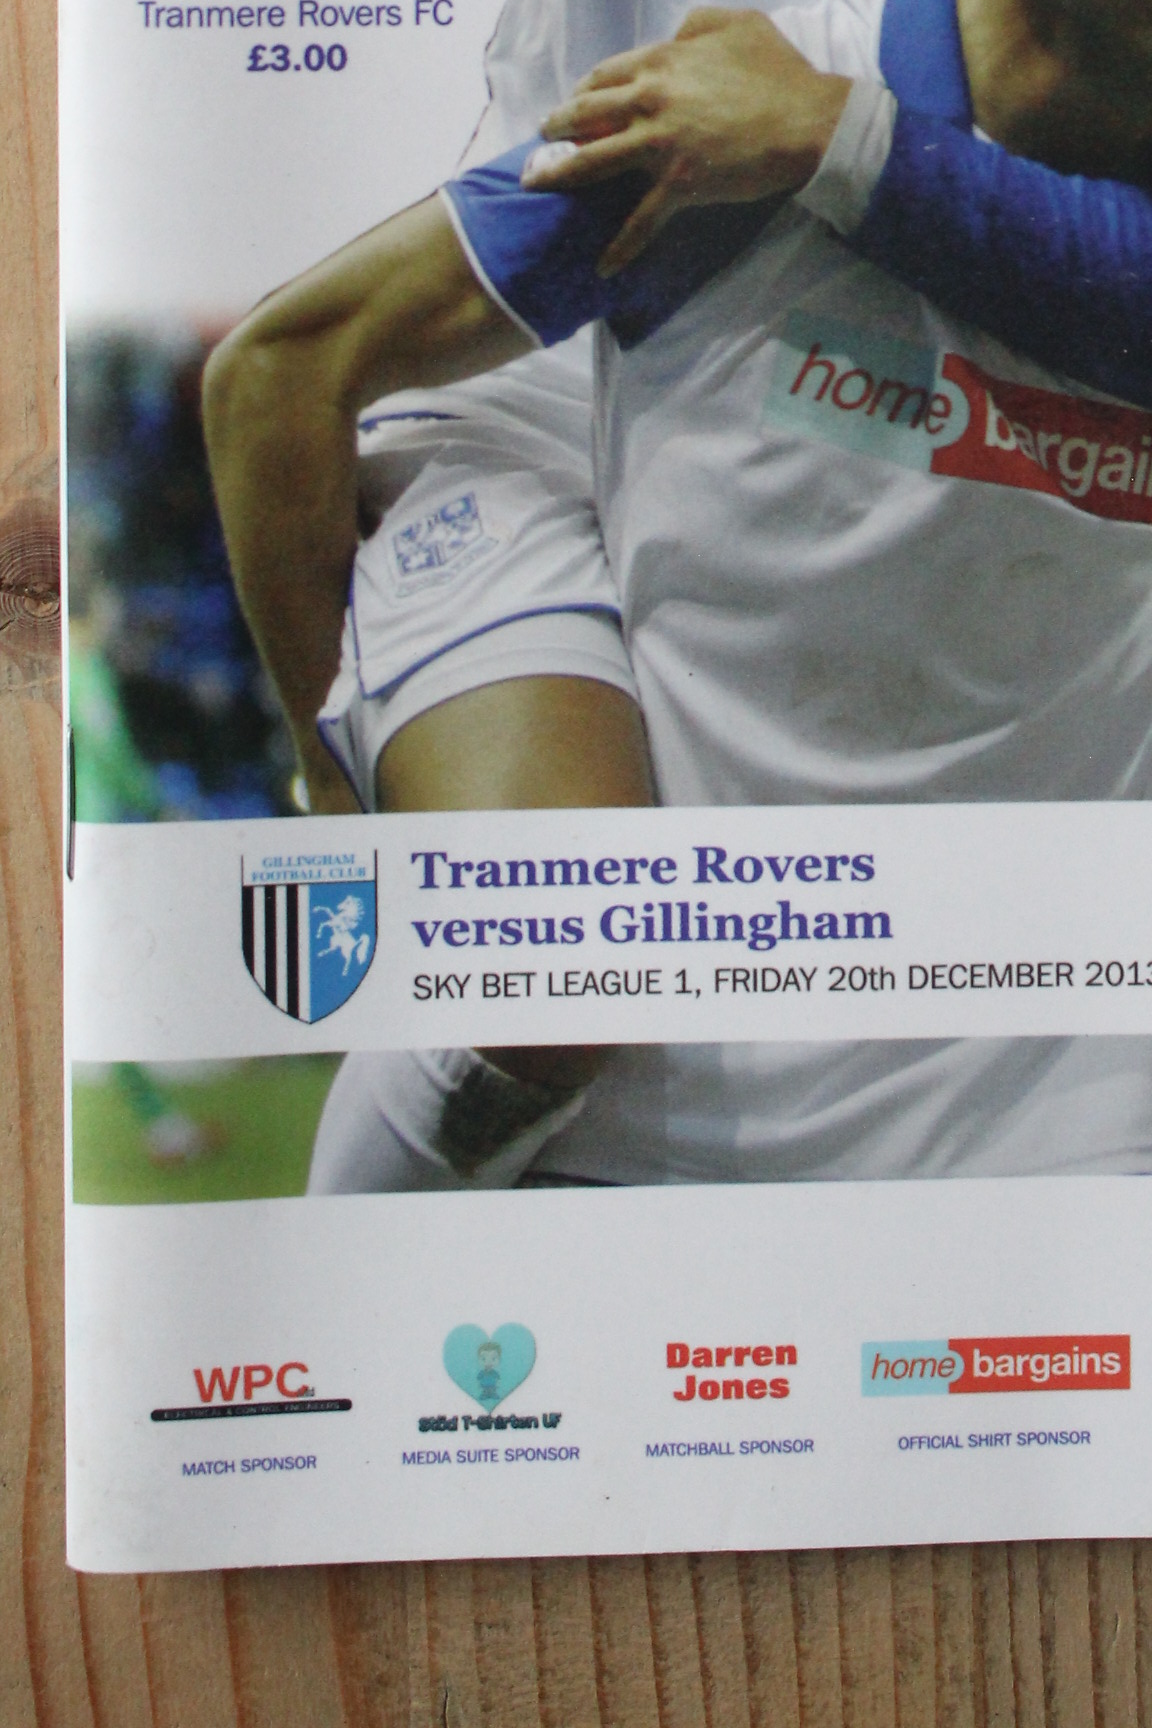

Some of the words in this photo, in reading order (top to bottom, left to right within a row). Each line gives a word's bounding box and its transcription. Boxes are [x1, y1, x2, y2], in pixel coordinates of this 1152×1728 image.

[138, 0, 286, 28] Tranmere
[299, 0, 402, 27] Rovers
[247, 43, 349, 72] £3.00
[787, 342, 953, 434] home
[251, 867, 323, 882] FOOTBALL
[329, 865, 367, 880] CLUB
[262, 853, 356, 868] GILLINGHAM
[411, 849, 678, 891] Tranmere
[693, 847, 875, 885] Rovers
[412, 913, 585, 948] versus
[599, 900, 893, 951] Gillingham
[412, 974, 475, 1001] SKY
[482, 973, 537, 999] BET
[548, 970, 662, 998] LEAGUE
[673, 970, 701, 1000] 1,
[714, 967, 818, 995] FRIDAY
[827, 966, 896, 992] 20th
[908, 961, 1075, 991] DECEMBER
[666, 1343, 798, 1369] Darren
[871, 1353, 956, 1380] home
[971, 1345, 1122, 1384] bargains
[193, 1360, 311, 1404] WPC
[673, 1376, 791, 1402] Jones
[645, 1441, 735, 1458] MATCHBALL
[739, 1439, 815, 1456] SPONSOR
[898, 1434, 963, 1451] OFFICIAL
[968, 1433, 1012, 1449] SHIRT
[1017, 1430, 1092, 1447] SPONSOR
[182, 1459, 236, 1477] MATCH
[241, 1455, 317, 1473] SPONSOR
[402, 1450, 451, 1466] MEDIA
[456, 1448, 499, 1463] SUITE
[504, 1446, 580, 1463] SPONSOR
